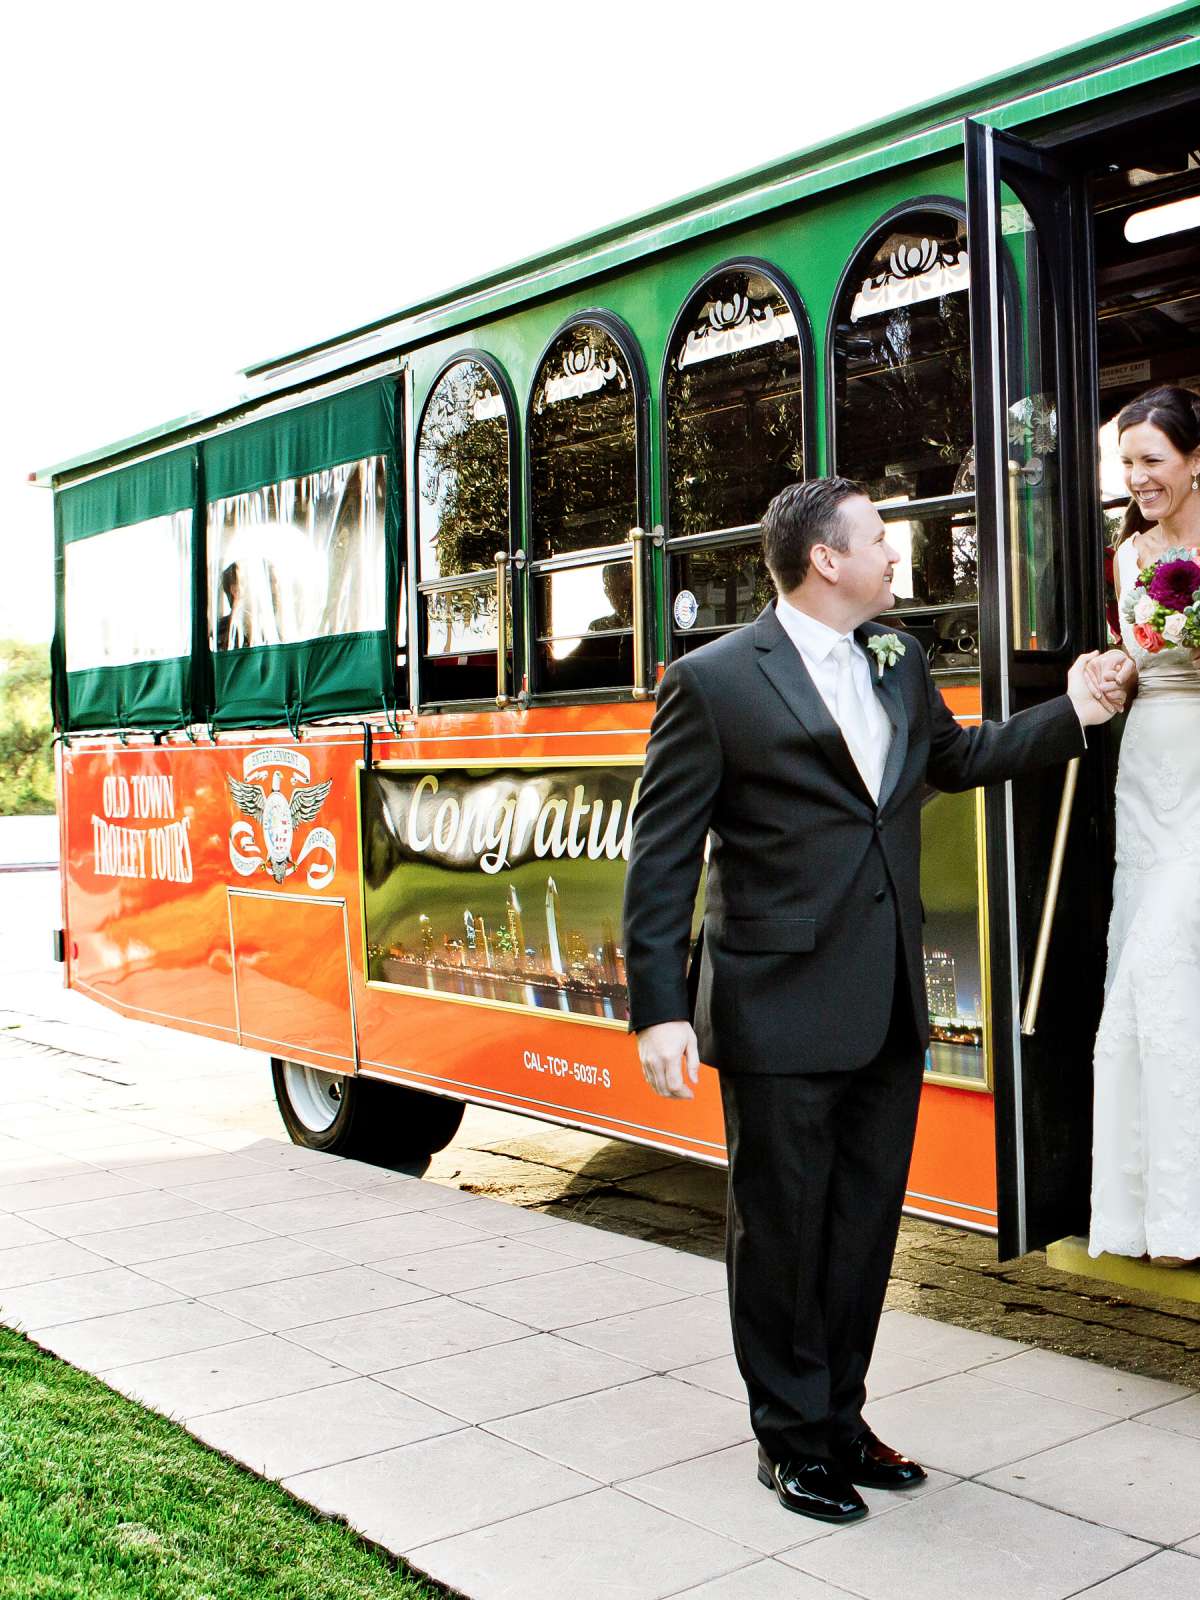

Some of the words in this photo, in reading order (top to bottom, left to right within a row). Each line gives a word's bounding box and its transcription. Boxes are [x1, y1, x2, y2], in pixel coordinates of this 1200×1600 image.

[103, 775, 130, 818] OLD
[130, 775, 175, 818] TOWN
[91, 814, 146, 880] TROLLEY
[148, 816, 193, 884] TOURS
[523, 1050, 612, 1089] CAL-TCP-5037-S
